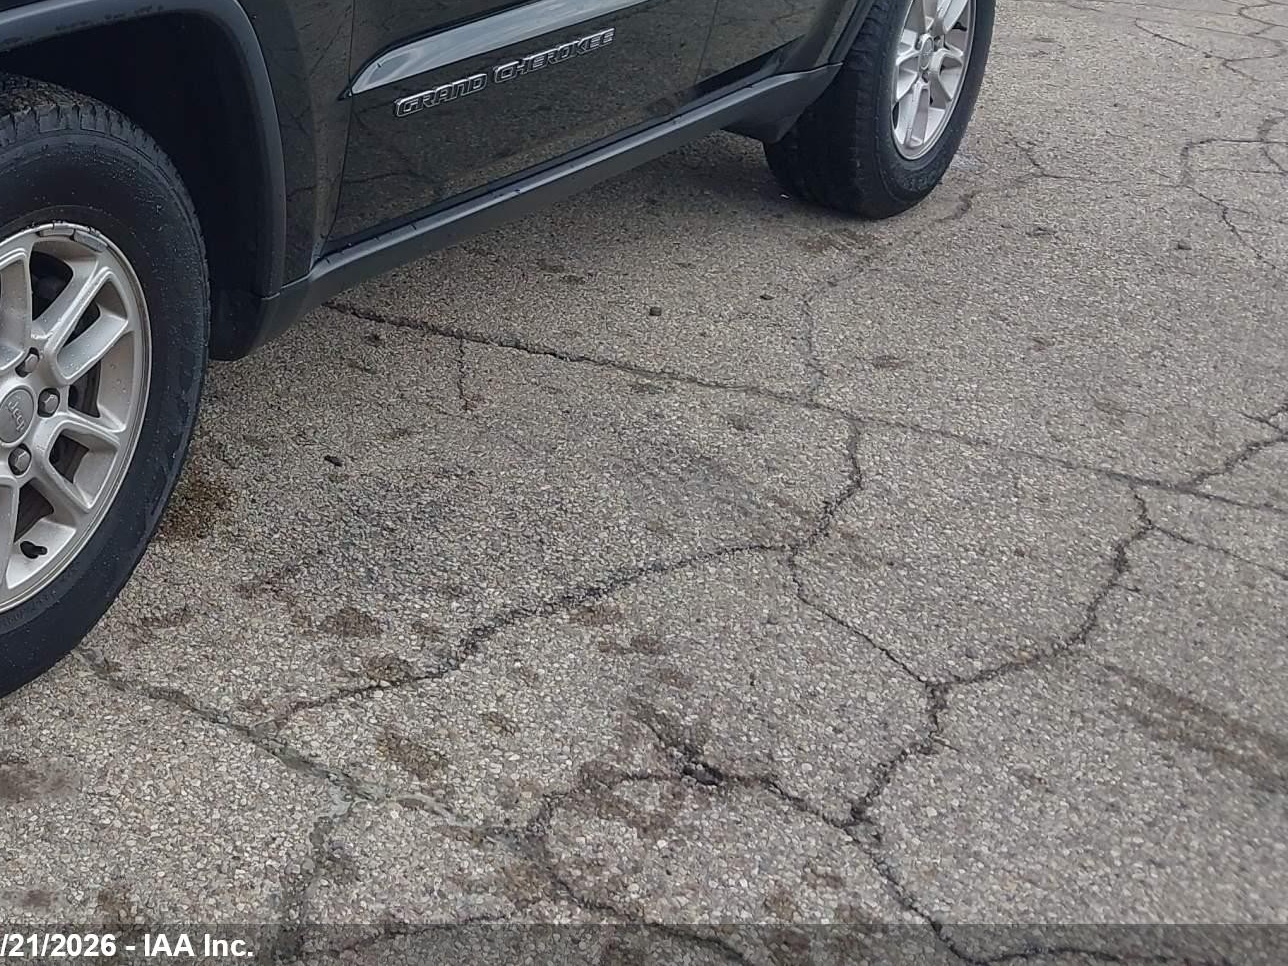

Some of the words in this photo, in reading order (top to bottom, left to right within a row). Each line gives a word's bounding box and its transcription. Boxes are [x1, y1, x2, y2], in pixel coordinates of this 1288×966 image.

[394, 73, 487, 117] GRAND
[493, 28, 615, 83] CHEROKEE
[6, 400, 27, 434] Jeep
